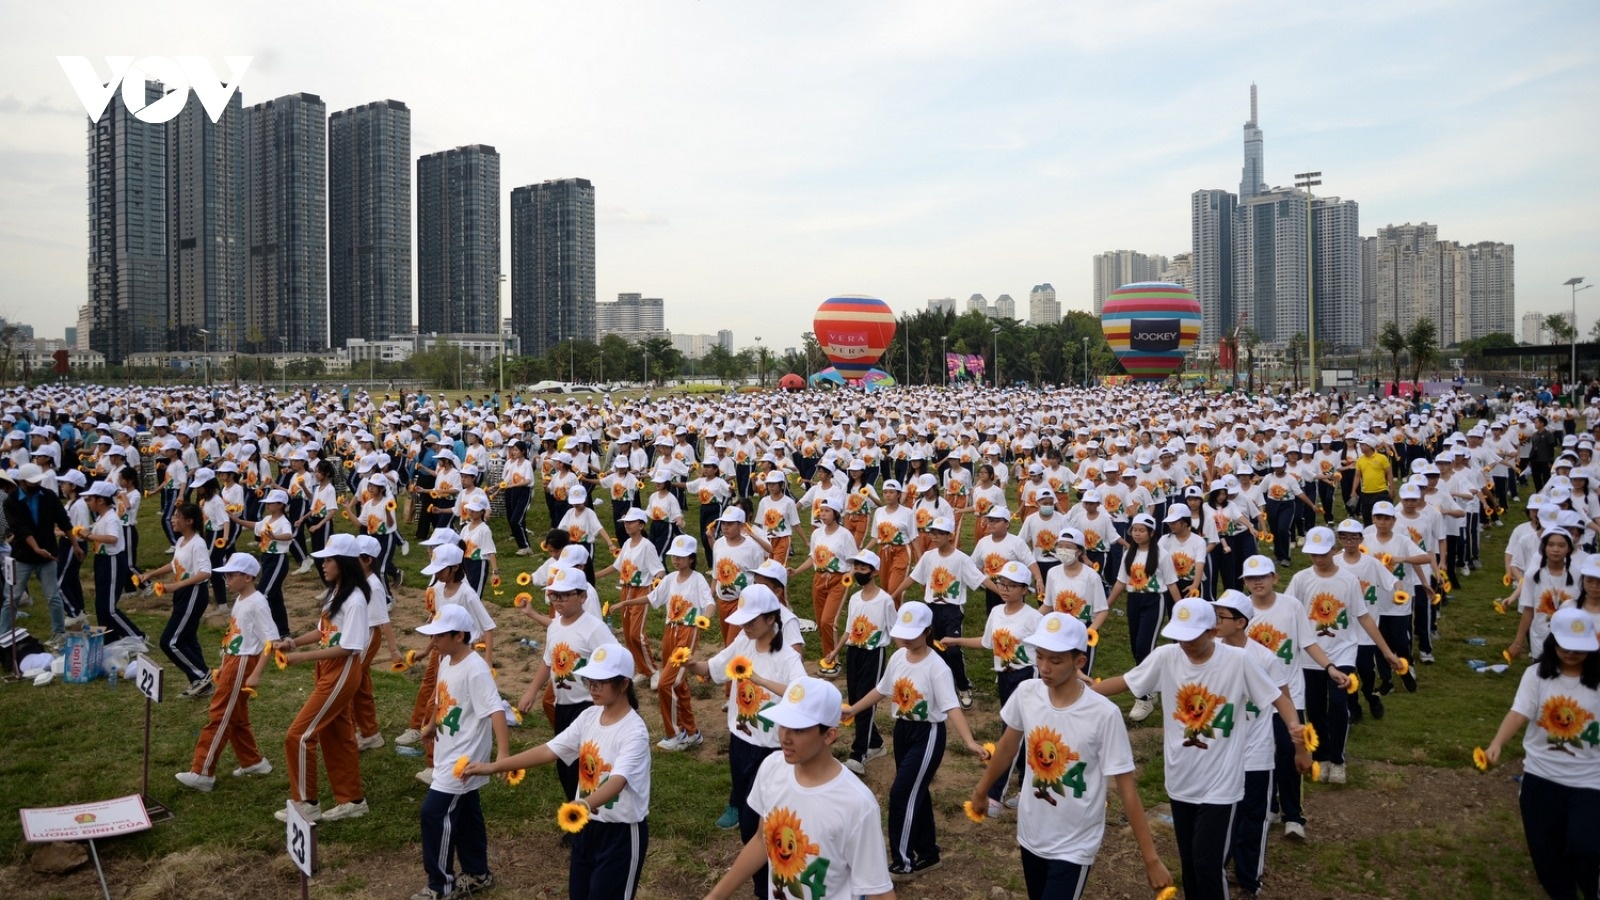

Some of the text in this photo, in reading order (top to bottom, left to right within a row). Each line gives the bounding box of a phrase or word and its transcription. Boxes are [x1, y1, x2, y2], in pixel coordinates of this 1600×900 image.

[830, 334, 865, 342] VERA
[1134, 332, 1177, 341] JOCKEY
[831, 345, 865, 354] VERA
[948, 581, 961, 599] 4
[1148, 575, 1160, 592] 4
[1364, 585, 1377, 605] 4
[1078, 604, 1091, 622] 4
[1337, 609, 1349, 629] 4
[1014, 645, 1029, 663] 4
[1276, 638, 1293, 664] 4
[141, 668, 154, 697] 22
[912, 700, 928, 721] 4
[1212, 703, 1234, 738] 4
[443, 706, 463, 736] 4
[1581, 720, 1600, 748] 4
[1062, 761, 1087, 798] 4
[32, 821, 144, 838] LƯƠNG ĐỊNH CỦA
[292, 822, 305, 865] 23
[801, 857, 830, 900] 4
